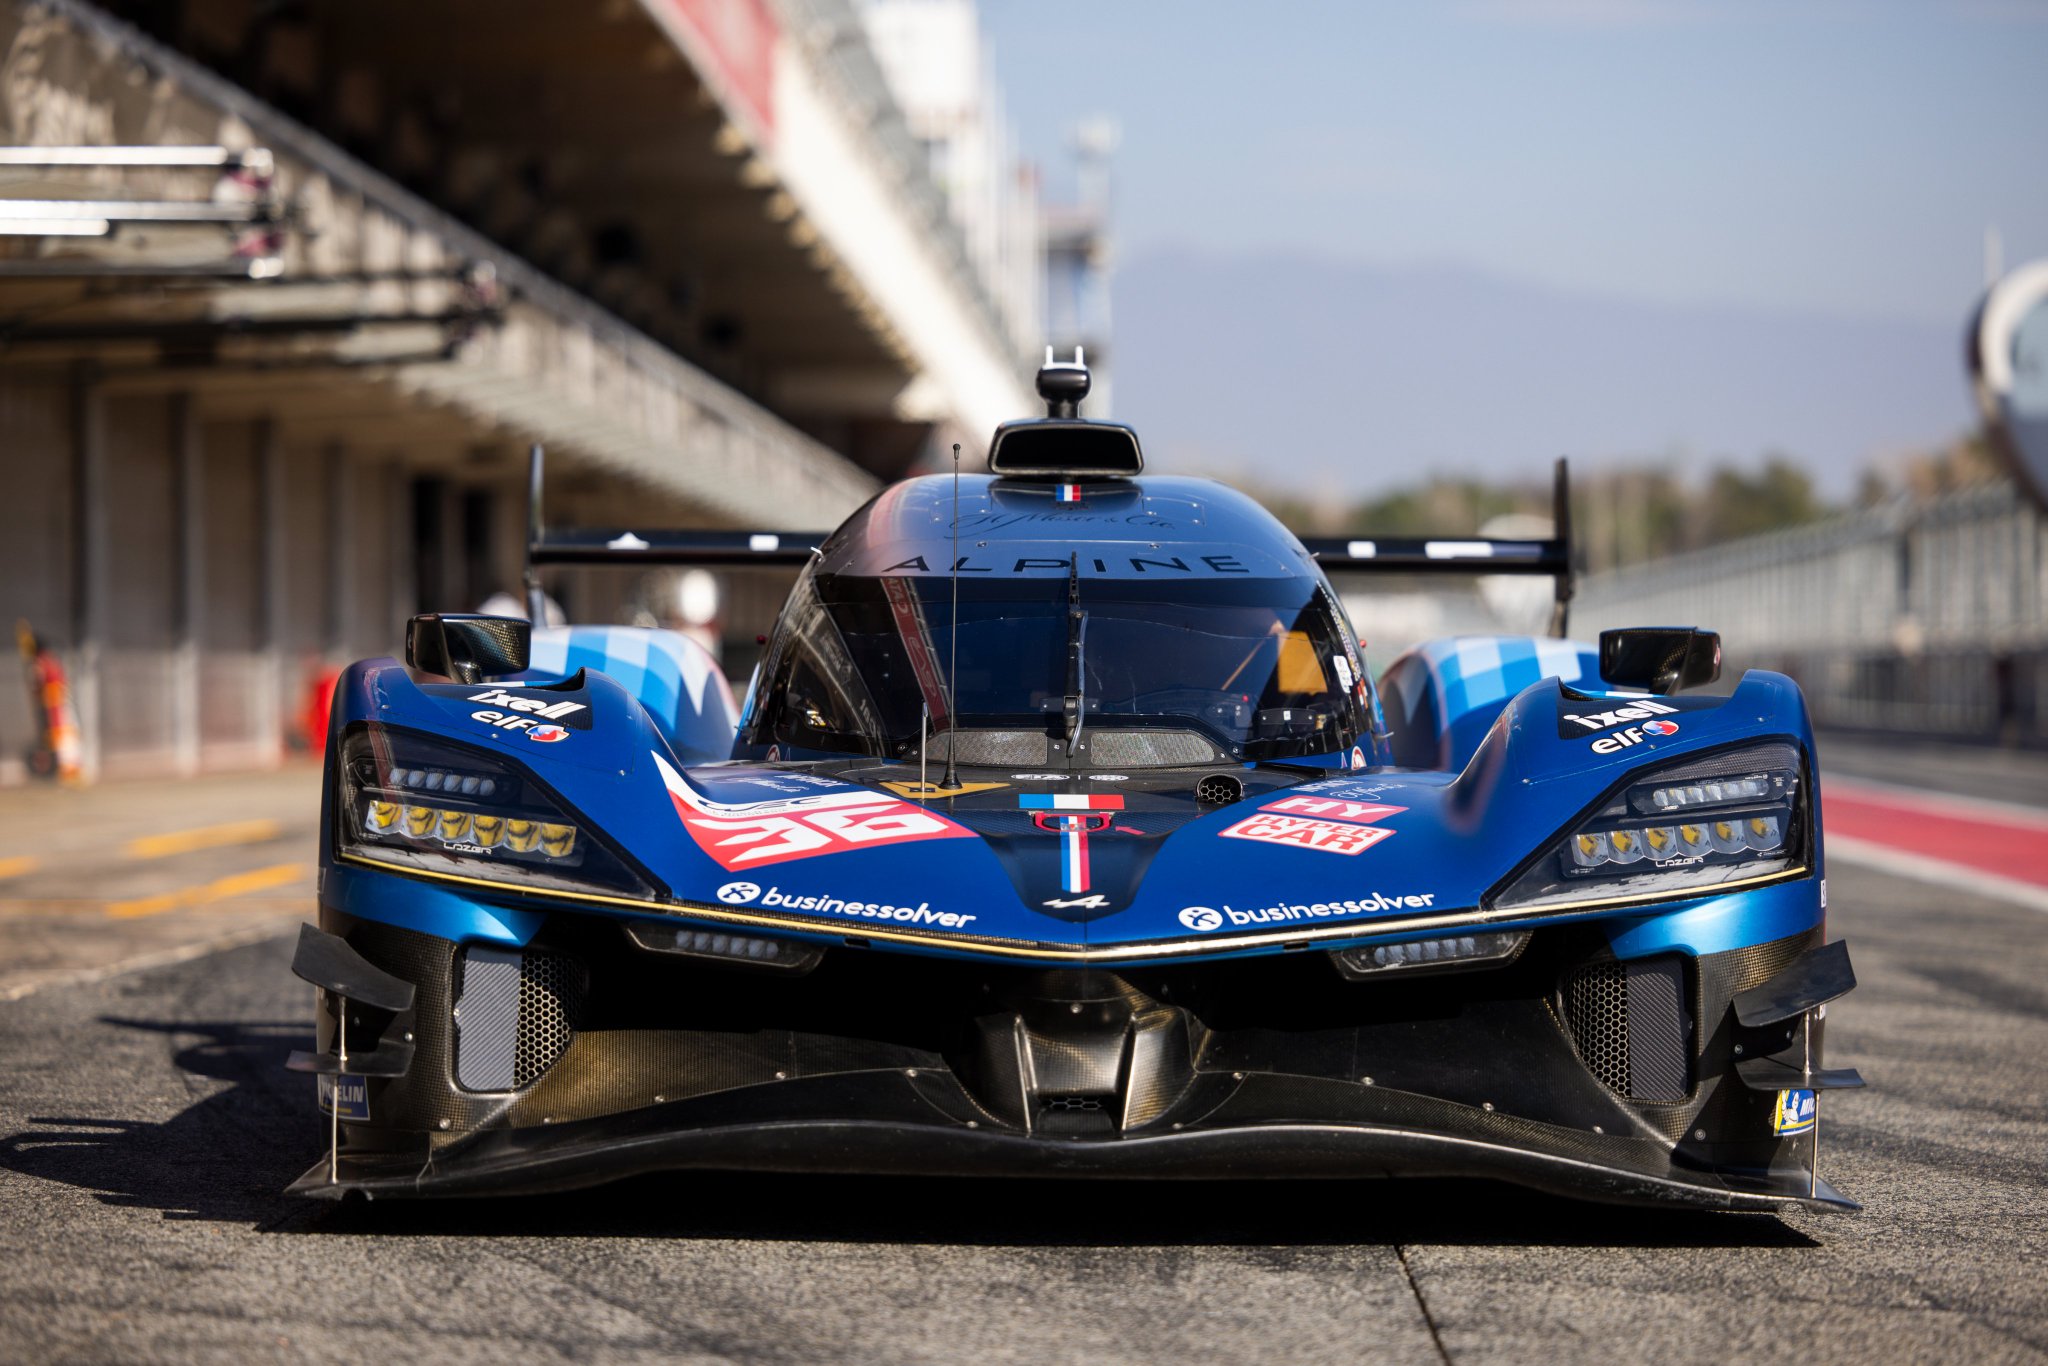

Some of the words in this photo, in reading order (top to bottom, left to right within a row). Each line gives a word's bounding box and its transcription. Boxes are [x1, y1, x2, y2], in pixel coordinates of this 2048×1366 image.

[883, 555, 1250, 573] ALPINE
[467, 689, 587, 719] ixell
[1563, 700, 1680, 730] ixell
[471, 710, 539, 730] elf
[1591, 727, 1643, 754] elf
[1271, 797, 1396, 818] HY
[687, 803, 950, 864] 36
[1236, 823, 1366, 851] CAR
[1254, 816, 1380, 838] HYPER
[761, 886, 977, 929] businessolver
[1223, 892, 1435, 926] businessolver
